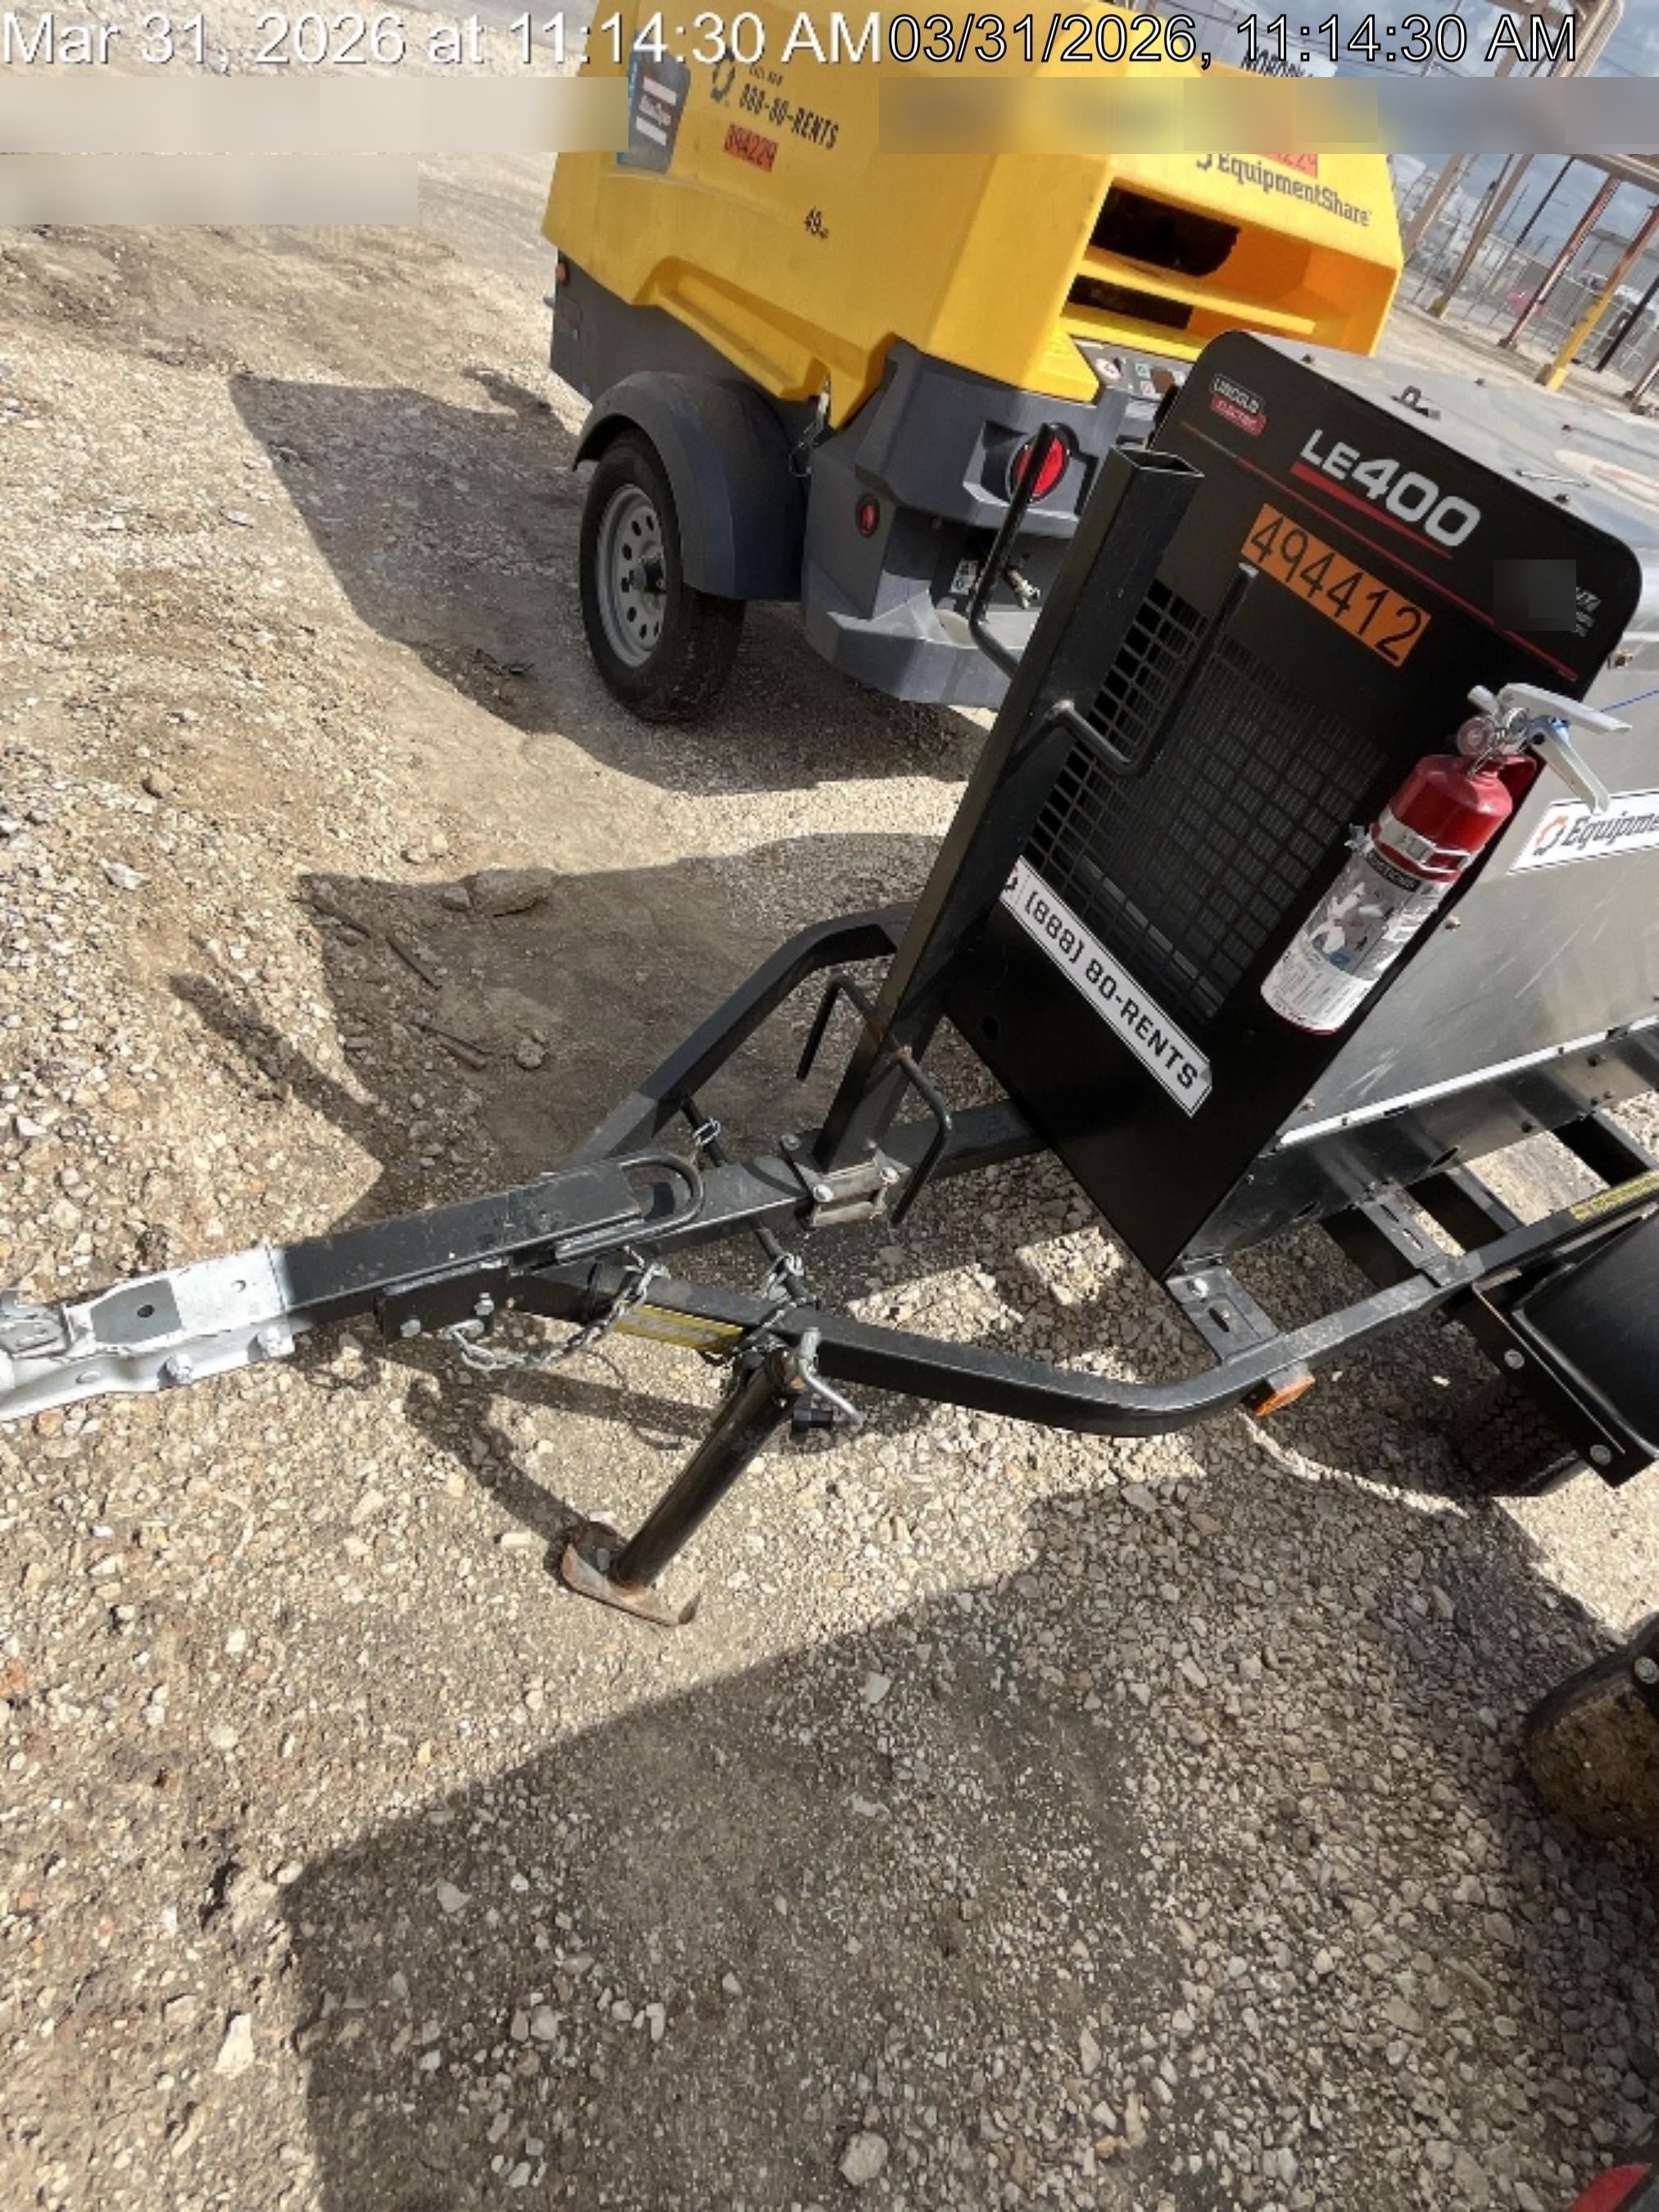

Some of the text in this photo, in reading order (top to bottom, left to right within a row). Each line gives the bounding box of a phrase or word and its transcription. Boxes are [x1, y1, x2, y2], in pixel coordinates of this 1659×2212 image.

[1299, 428, 1481, 547] LE400
[1250, 515, 1422, 661] 494412
[1024, 891, 1198, 1090] (888) 80-RENTS
